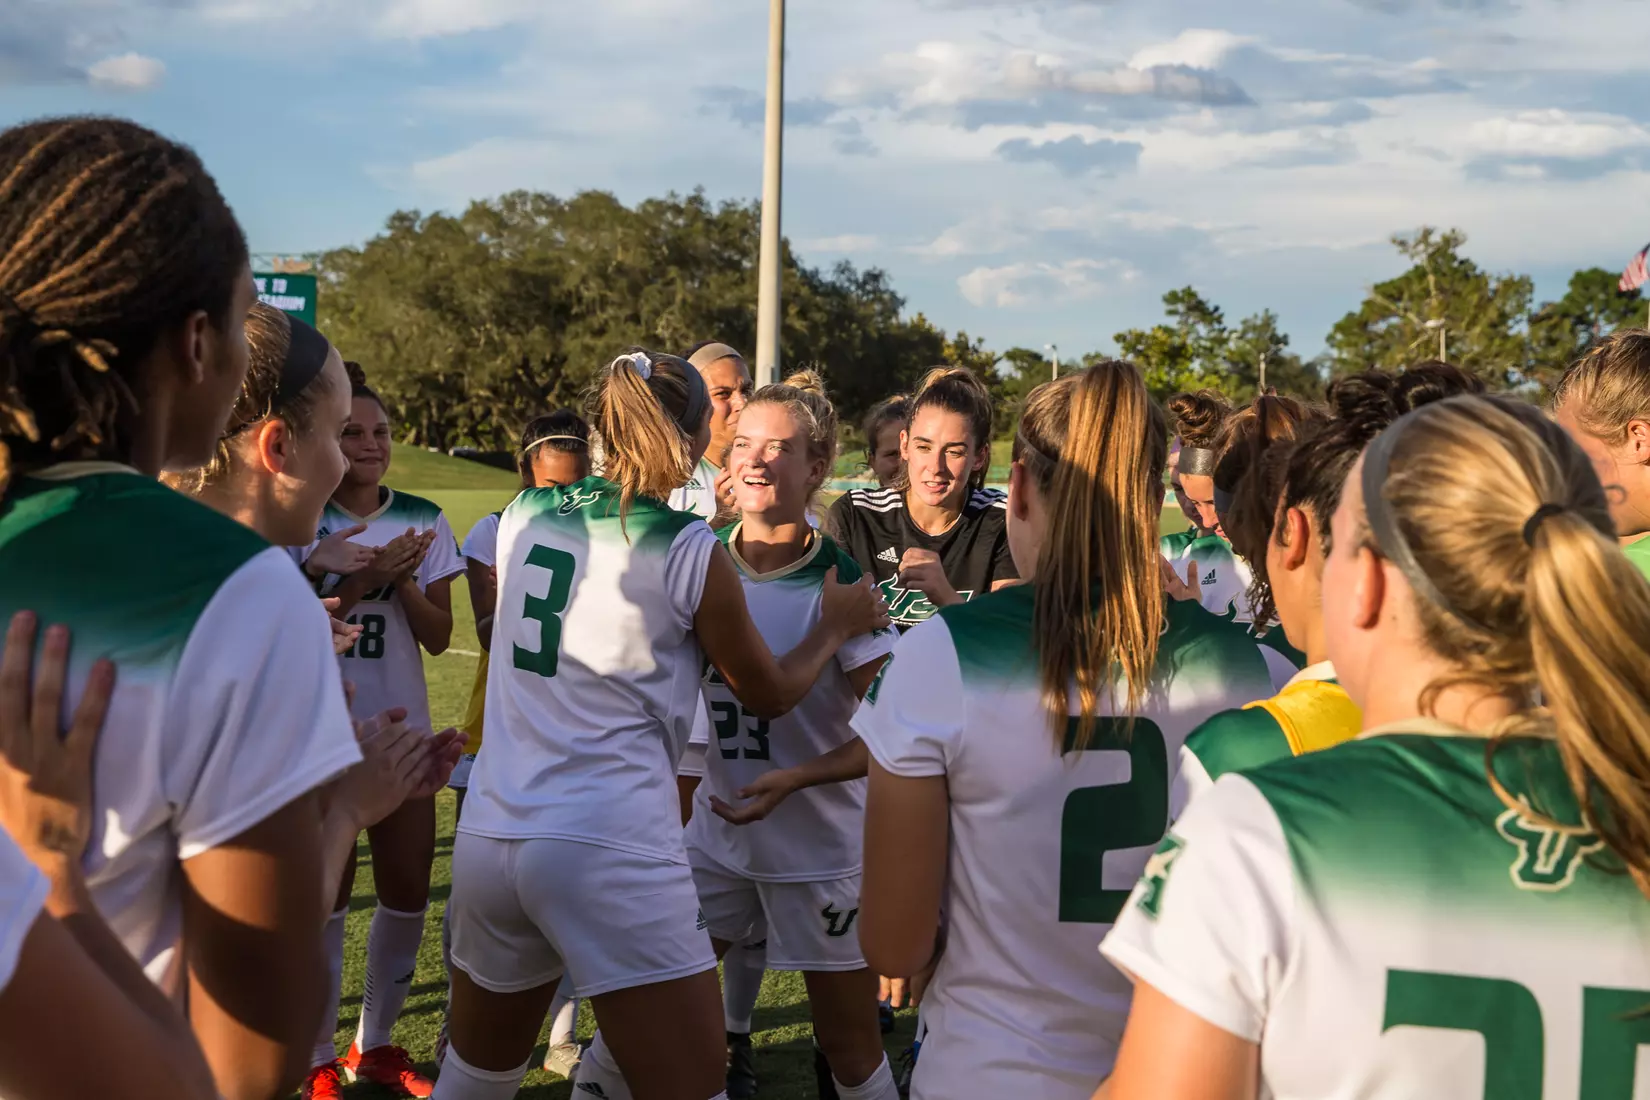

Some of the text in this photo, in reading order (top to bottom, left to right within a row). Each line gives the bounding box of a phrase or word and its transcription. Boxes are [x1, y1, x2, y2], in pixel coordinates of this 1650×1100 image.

[272, 278, 287, 294] TO
[877, 553, 899, 563] adidas
[344, 613, 386, 659] 18
[513, 543, 576, 678] 3
[710, 701, 770, 760] 23
[1058, 716, 1168, 923] 2
